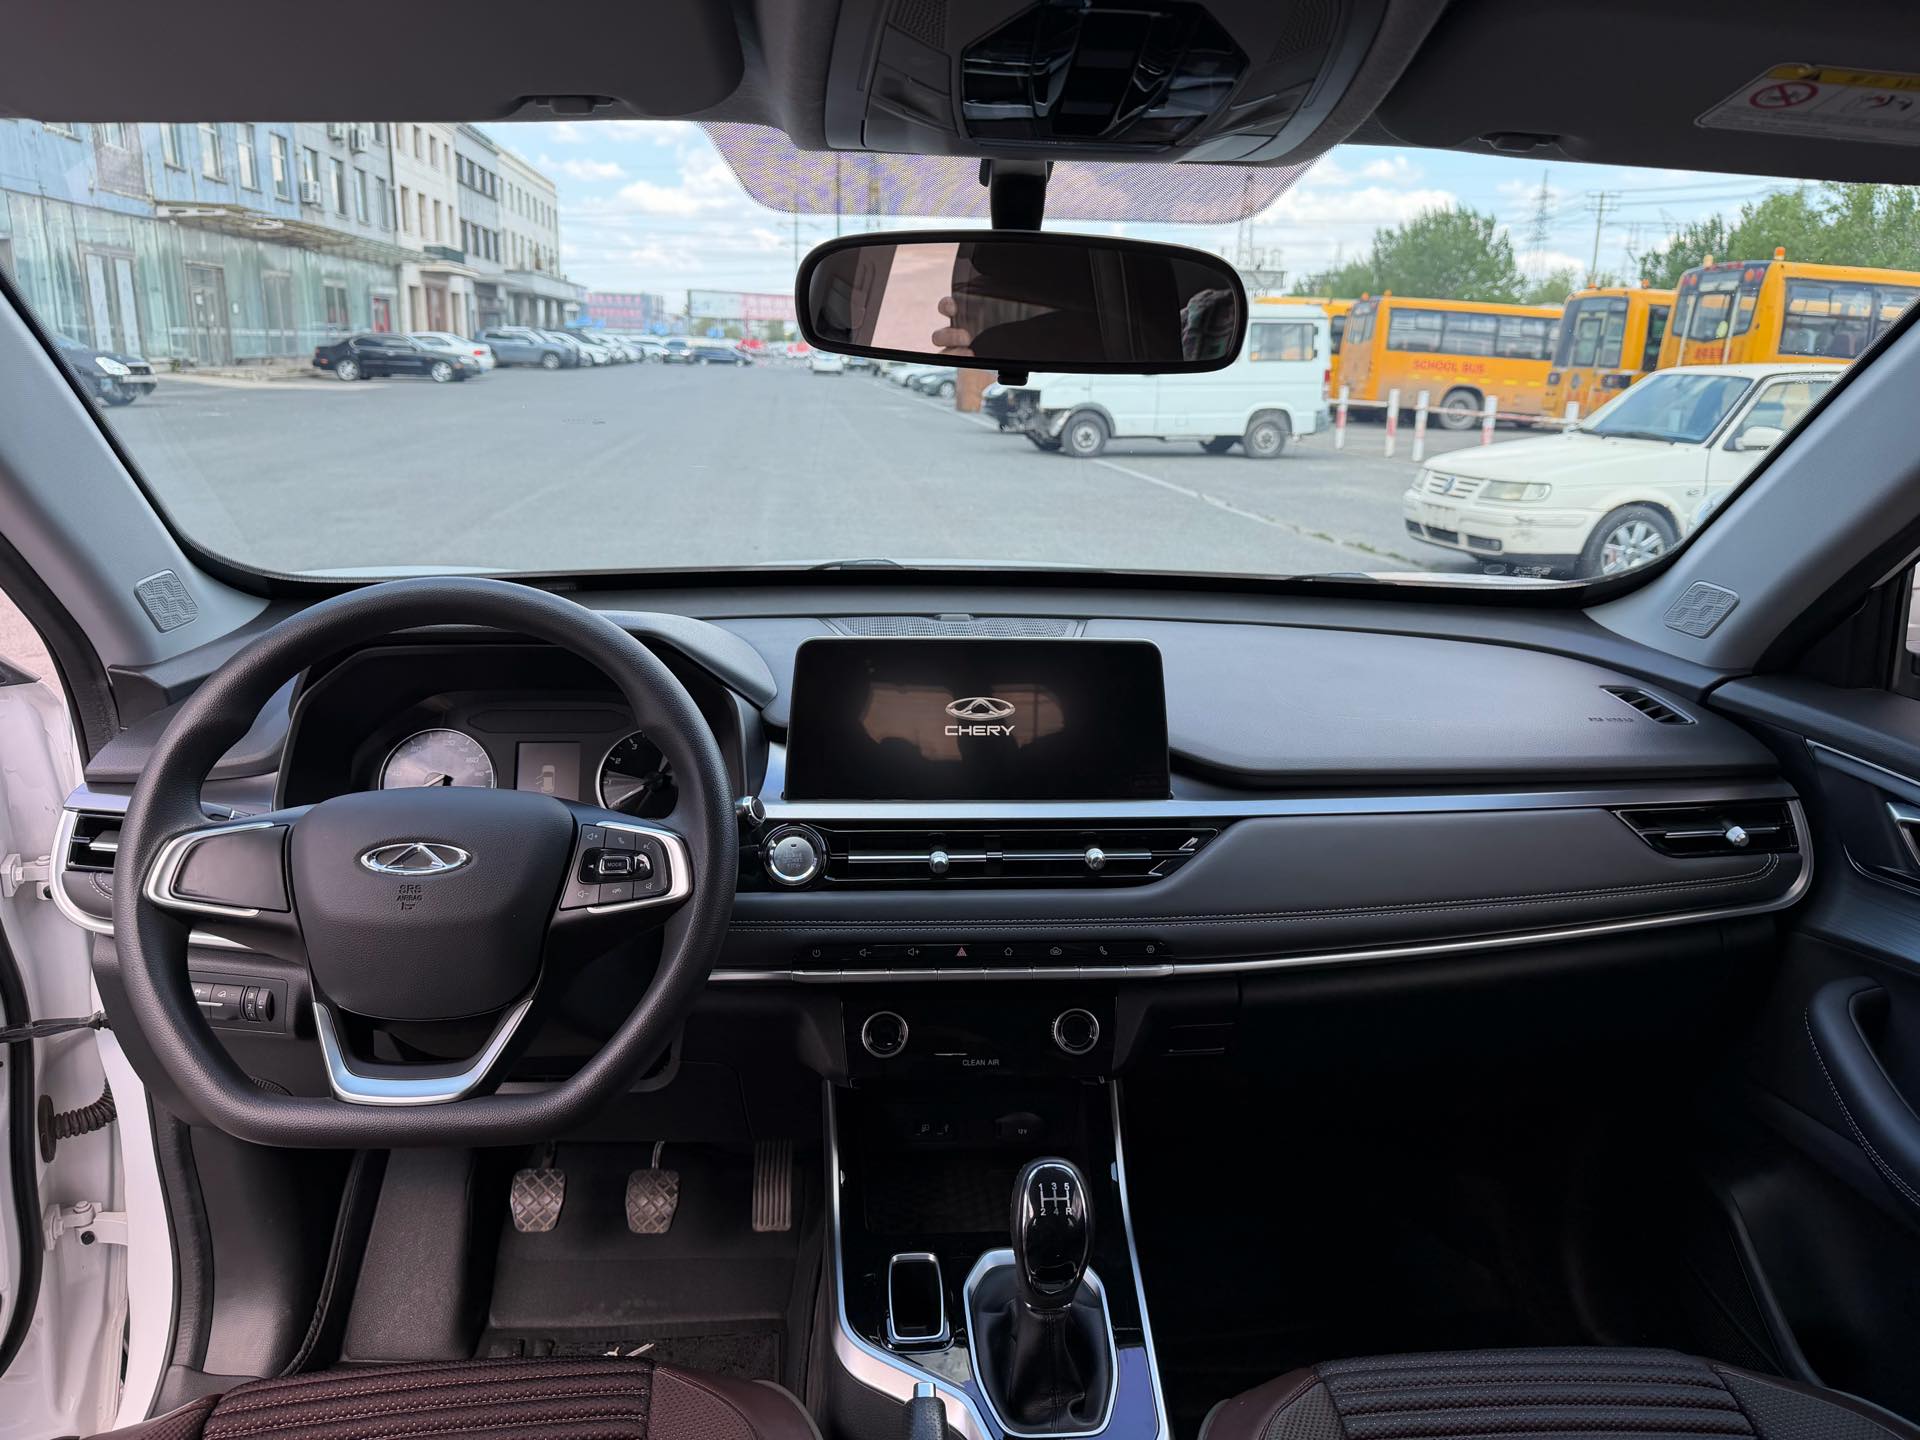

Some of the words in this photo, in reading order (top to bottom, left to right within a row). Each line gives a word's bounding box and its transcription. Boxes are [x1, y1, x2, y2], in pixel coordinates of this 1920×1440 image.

[1412, 359, 1457, 373] SCHOOL
[944, 725, 1016, 736] CHERY
[962, 1059, 986, 1067] CLEAN
[987, 1059, 1001, 1067] AIR
[1051, 1182, 1058, 1190] 3
[1064, 1182, 1071, 1190] 5
[1040, 1207, 1047, 1216] 2
[1065, 1207, 1073, 1216] R
